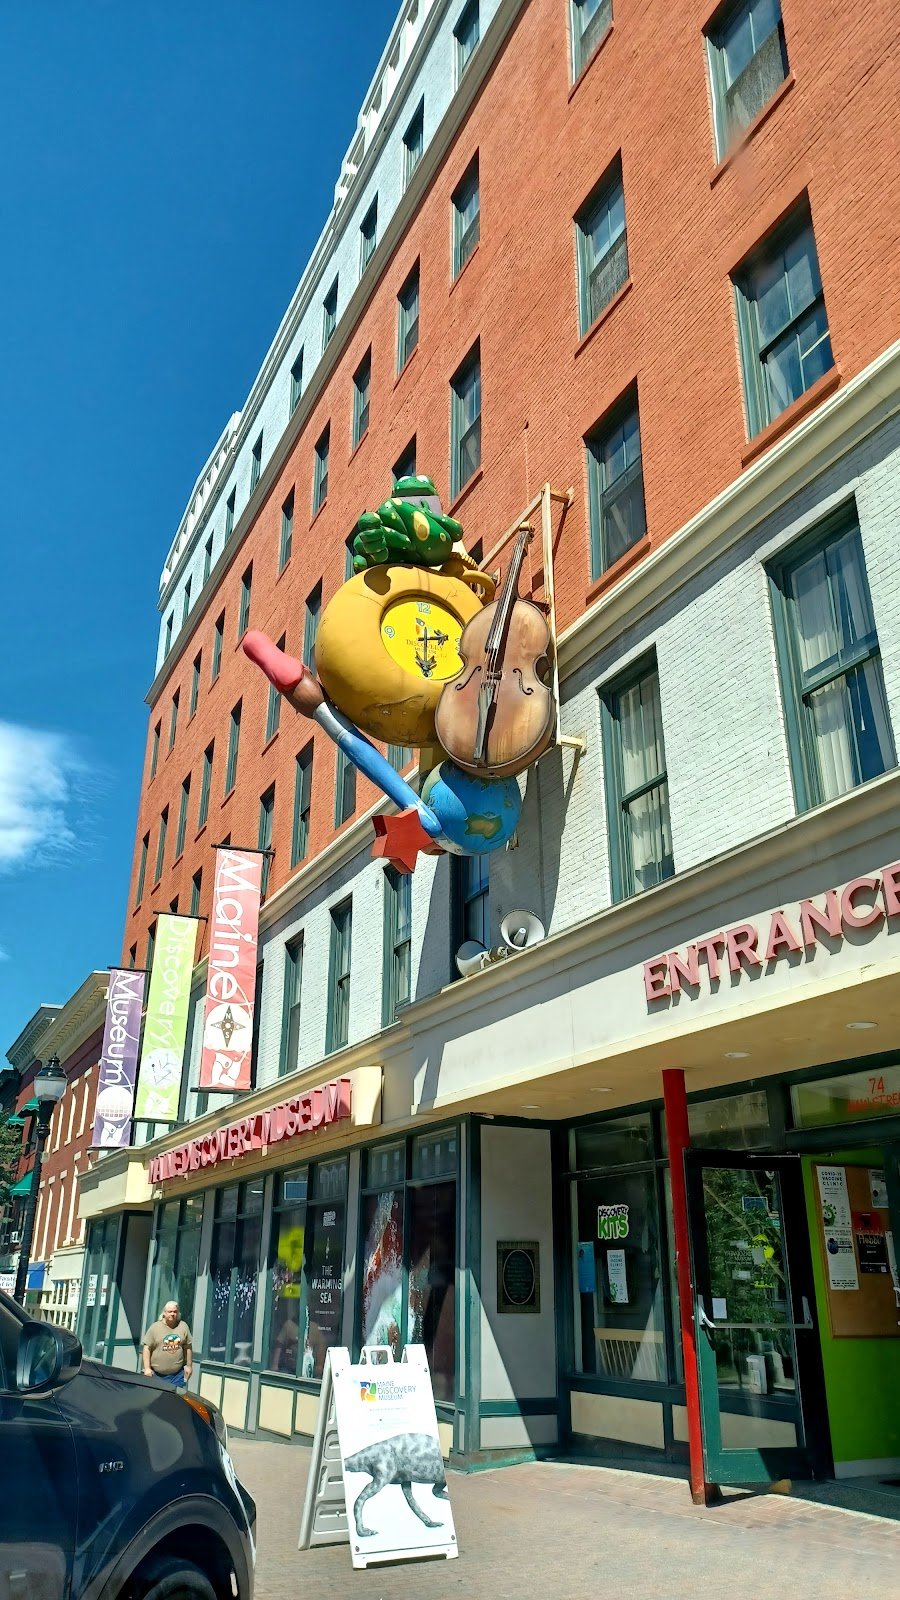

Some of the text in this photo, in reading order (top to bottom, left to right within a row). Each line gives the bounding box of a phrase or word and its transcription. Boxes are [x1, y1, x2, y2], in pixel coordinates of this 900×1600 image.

[416, 601, 431, 614] 12
[384, 625, 395, 638] 9
[209, 850, 259, 1000] Maine
[643, 862, 900, 1001] ENTRANCE
[150, 916, 192, 1046] Discovery
[104, 971, 140, 1085] Museum
[868, 1076, 884, 1094] 74
[180, 1115, 262, 1172] DISCOVERY
[262, 1079, 351, 1146] MUSEUM
[599, 1215, 627, 1238] KITS
[321, 1265, 333, 1276] THE
[311, 1279, 342, 1290] WARMING
[319, 1292, 332, 1304] SEA
[378, 1386, 416, 1395] DISCOVERY
